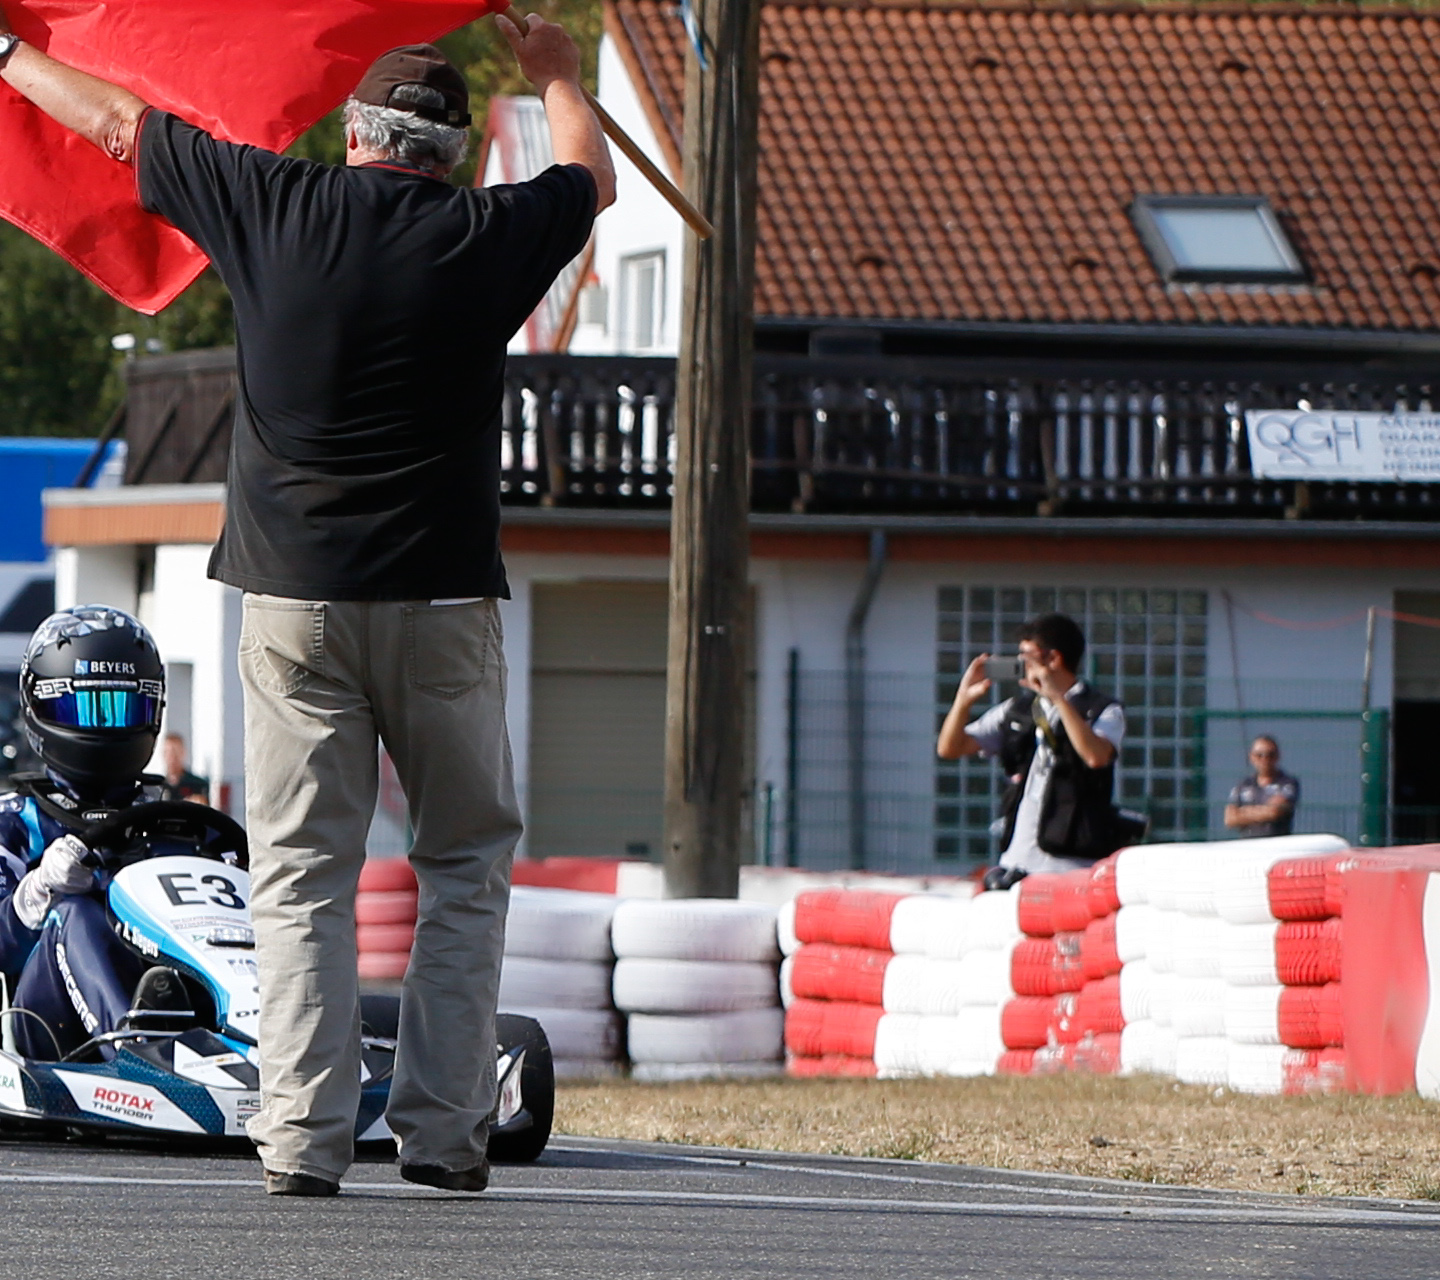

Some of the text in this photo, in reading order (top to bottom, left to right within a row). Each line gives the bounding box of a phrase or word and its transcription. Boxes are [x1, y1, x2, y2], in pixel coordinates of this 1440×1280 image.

[91, 661, 135, 675] BEYERS
[157, 872, 247, 910] E3
[92, 1100, 154, 1121] THUNDER
[93, 1086, 155, 1112] ROTAX
